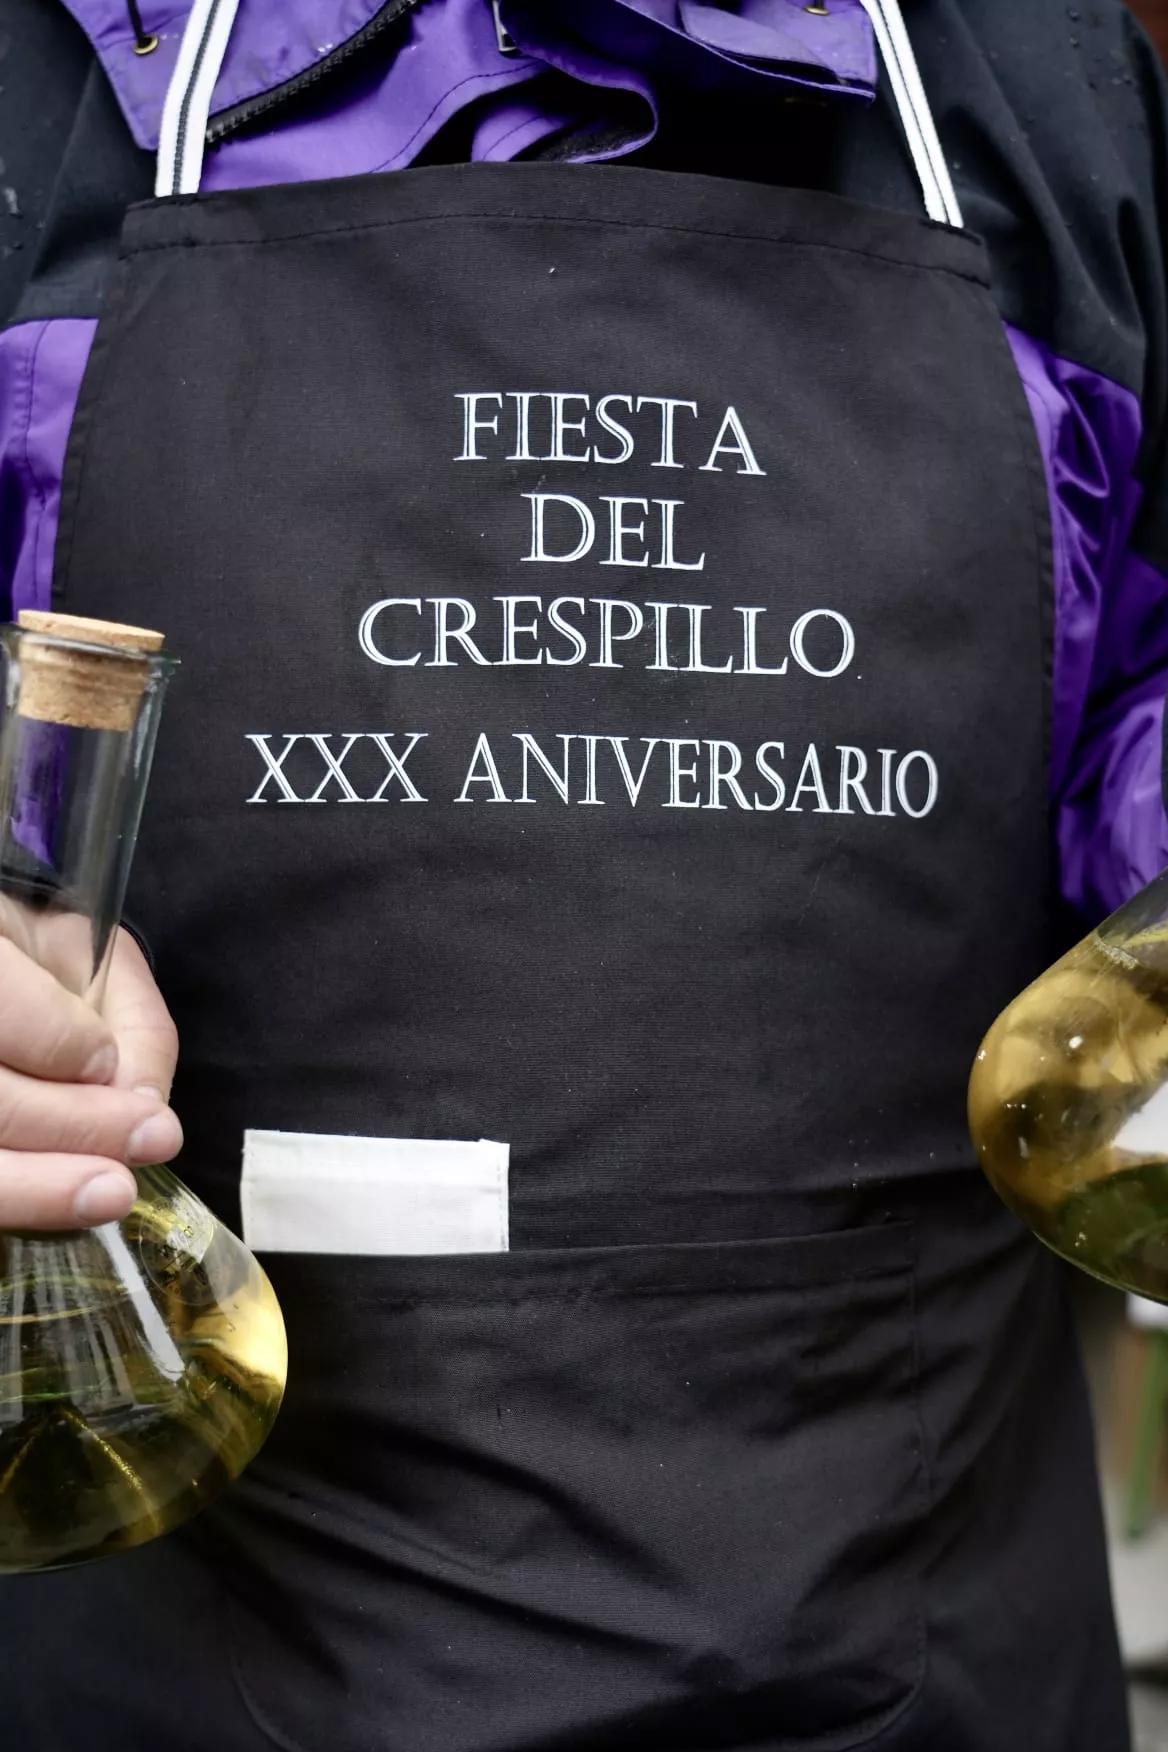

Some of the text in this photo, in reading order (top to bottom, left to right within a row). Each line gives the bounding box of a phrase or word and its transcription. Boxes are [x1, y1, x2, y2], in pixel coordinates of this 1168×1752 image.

[453, 392, 768, 476] FIESTA
[520, 492, 706, 571] DEL
[357, 596, 856, 678] CRESPILLO
[245, 733, 939, 819] XXX ANIVERSARIO
